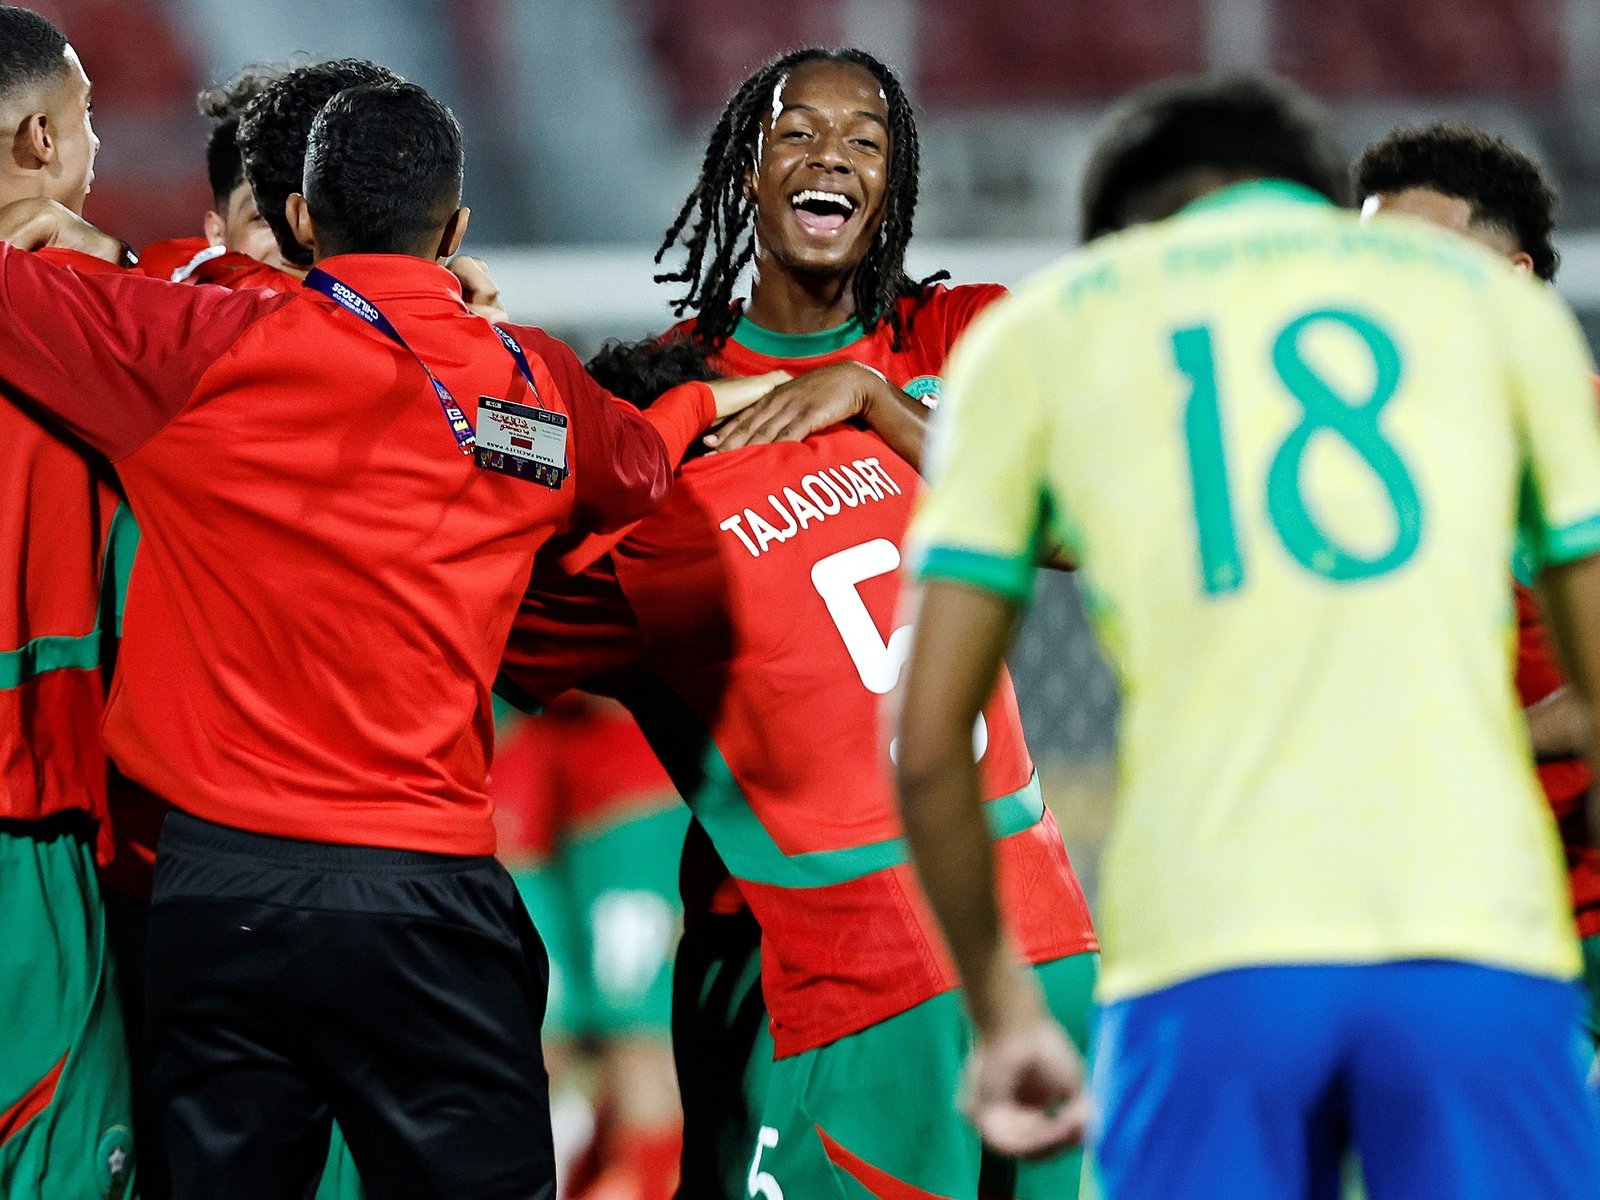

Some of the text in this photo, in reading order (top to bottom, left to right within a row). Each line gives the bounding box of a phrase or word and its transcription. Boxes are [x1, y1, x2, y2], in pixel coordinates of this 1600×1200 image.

[486, 442, 504, 450] PASS
[505, 447, 535, 458] FACILITY
[536, 454, 554, 463] TEAM
[1169, 308, 1422, 595] 18
[719, 457, 902, 557] TAJAOUART
[747, 1125, 784, 1200] 5
